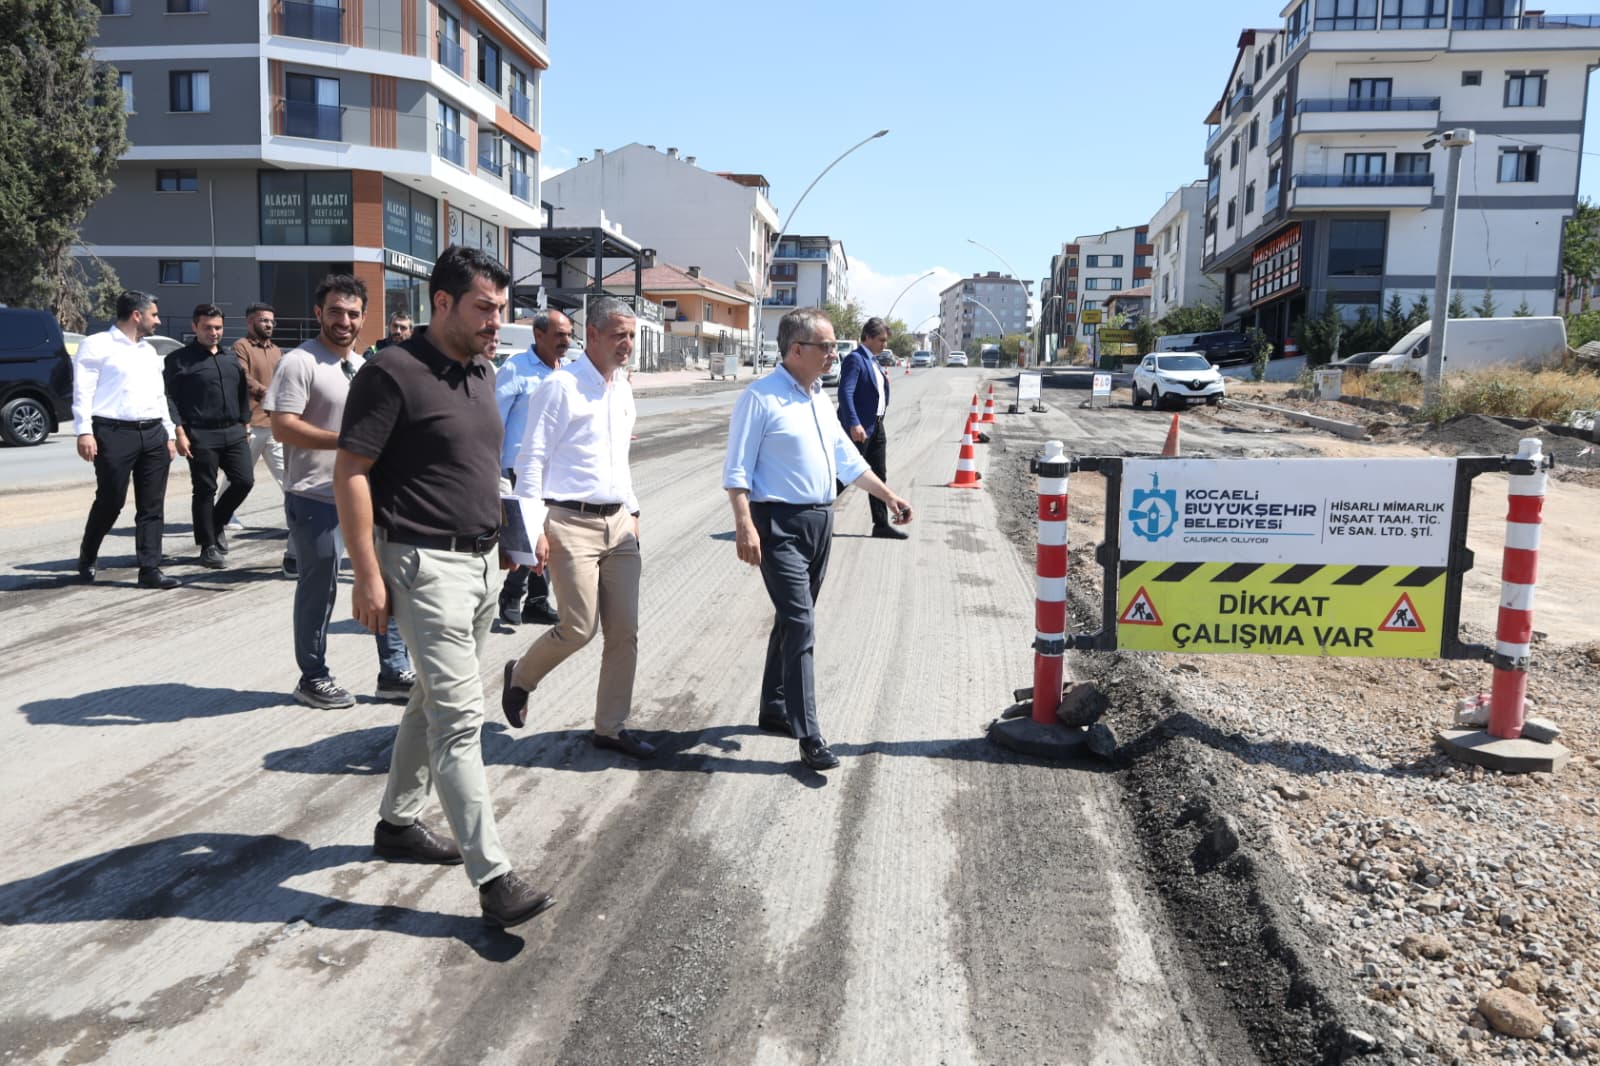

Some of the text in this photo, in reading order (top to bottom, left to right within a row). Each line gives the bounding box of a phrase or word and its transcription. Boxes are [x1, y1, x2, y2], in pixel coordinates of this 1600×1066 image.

[1330, 500, 1445, 512] HİSARLI MİMARLIK
[1329, 512, 1441, 525] İNŞAAT TAAH. TİC.
[1329, 525, 1433, 539] VE SAN. LTD. ŞTİ.
[1230, 537, 1269, 545] OLUYOR
[1218, 590, 1330, 617] DİKKAT
[1172, 623, 1375, 649] ÇALIŞMA VAR
